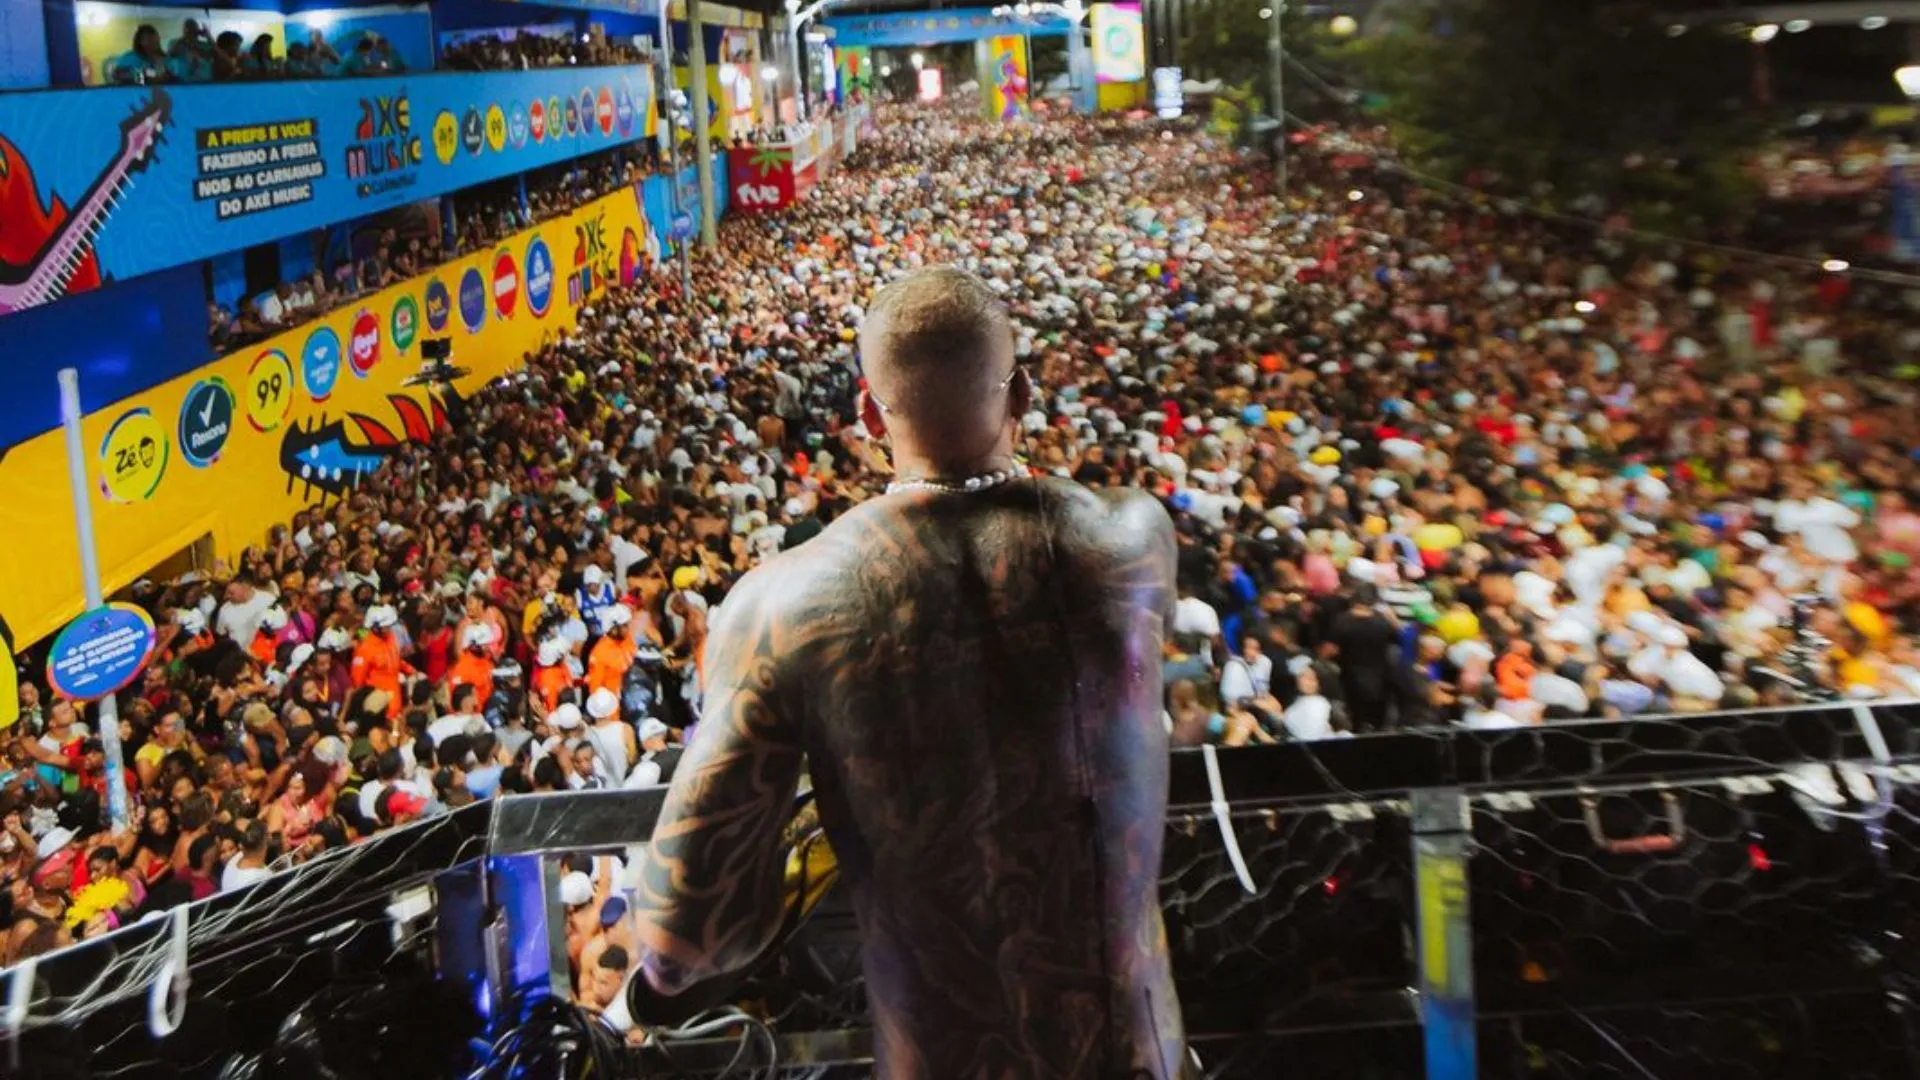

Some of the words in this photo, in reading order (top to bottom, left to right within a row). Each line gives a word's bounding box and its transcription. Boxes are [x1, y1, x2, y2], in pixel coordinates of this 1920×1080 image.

[207, 132, 219, 147] A
[268, 126, 278, 140] E
[202, 149, 267, 172] FAZENDO
[270, 147, 280, 161] A
[282, 141, 317, 160] FESTA
[198, 177, 232, 197] NOS
[234, 174, 254, 190] 40
[256, 161, 323, 187] CARNAVAIS
[220, 198, 242, 217] DO
[245, 189, 271, 211] AXÉ
[273, 184, 310, 205] MUSIC
[257, 374, 282, 410] 99
[192, 421, 227, 448] Rexona
[115, 445, 138, 475] Zé
